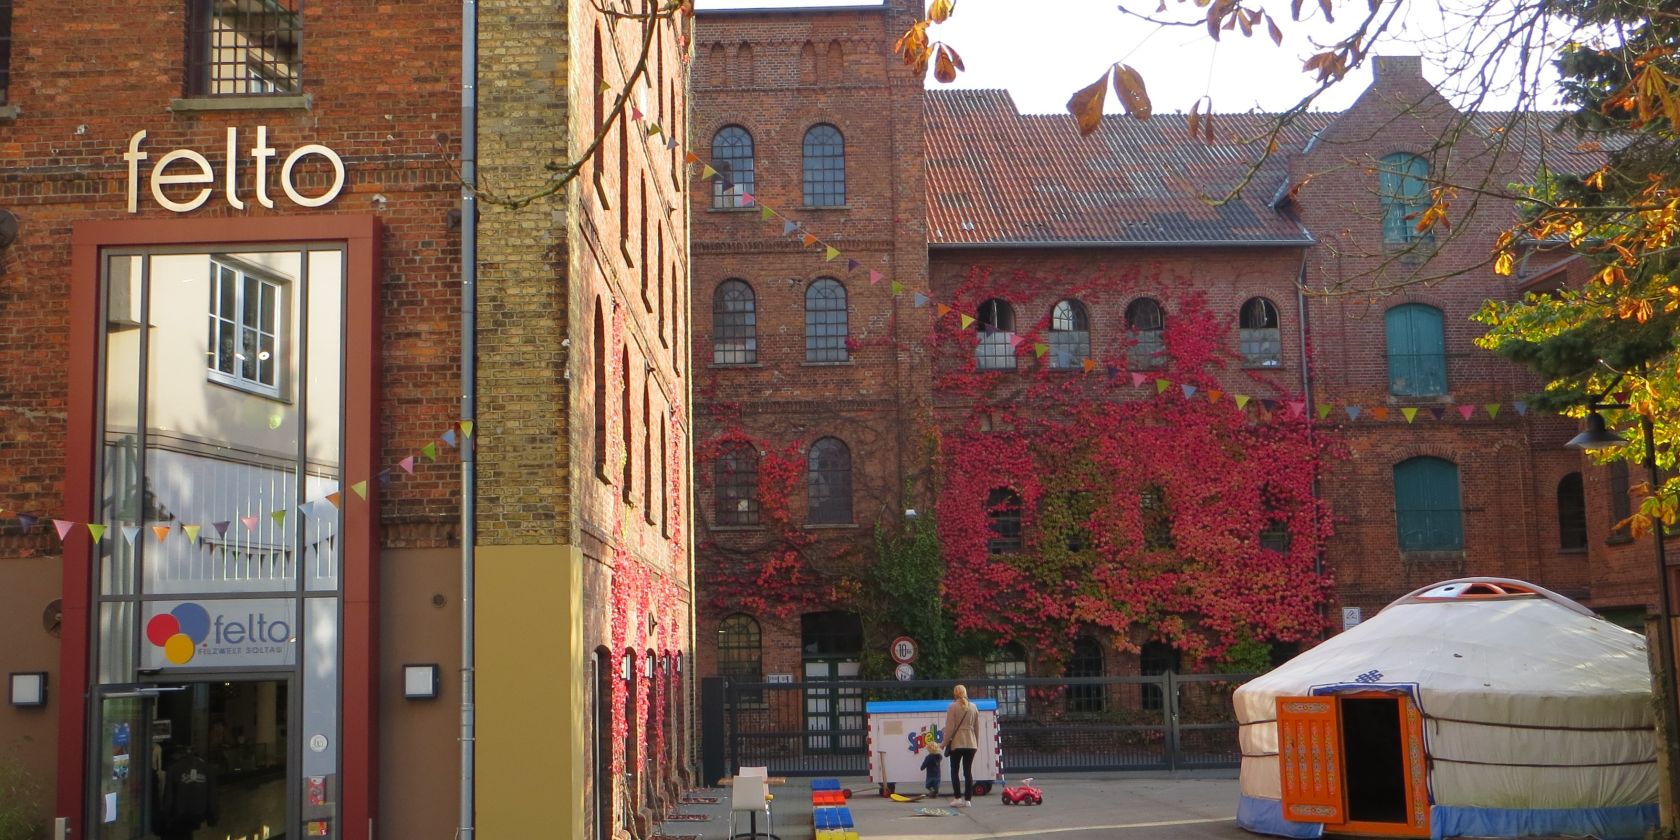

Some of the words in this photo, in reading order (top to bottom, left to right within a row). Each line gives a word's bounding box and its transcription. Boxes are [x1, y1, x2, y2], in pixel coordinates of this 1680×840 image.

[124, 125, 345, 213] felto
[214, 613, 290, 644] felto
[245, 646, 283, 654] SOLTAU
[909, 723, 944, 754] Spielb
